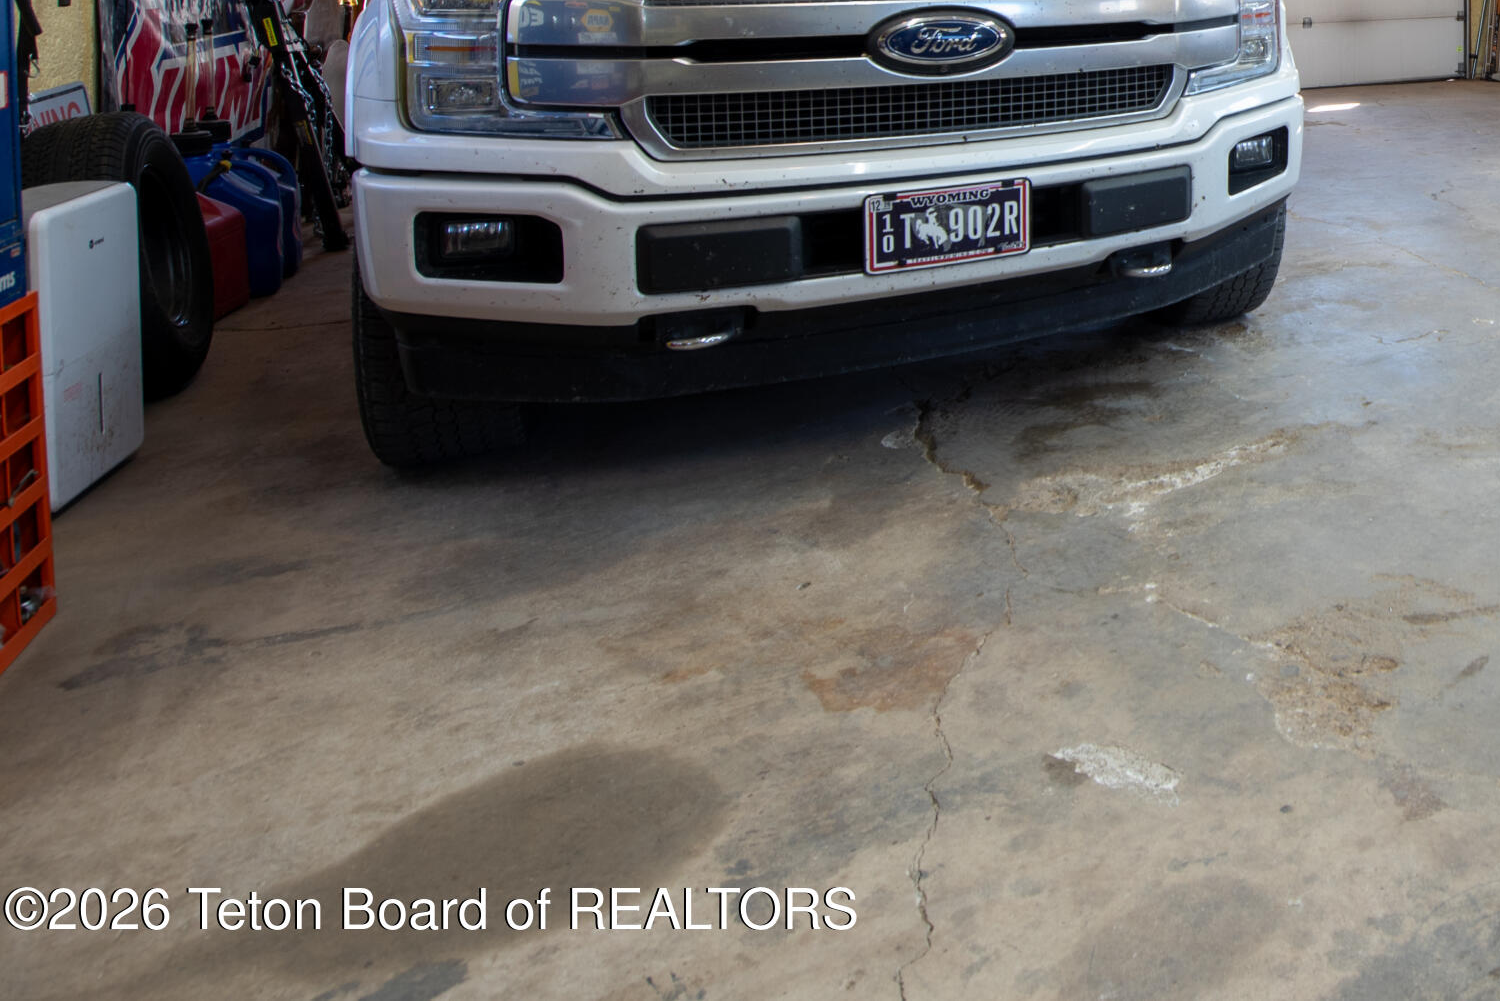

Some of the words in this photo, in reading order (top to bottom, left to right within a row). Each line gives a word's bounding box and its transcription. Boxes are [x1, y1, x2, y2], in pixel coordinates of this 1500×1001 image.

[911, 26, 982, 55] Ford
[910, 189, 990, 207] WYOMING
[900, 213, 915, 249] T
[949, 201, 1018, 243] 902R
